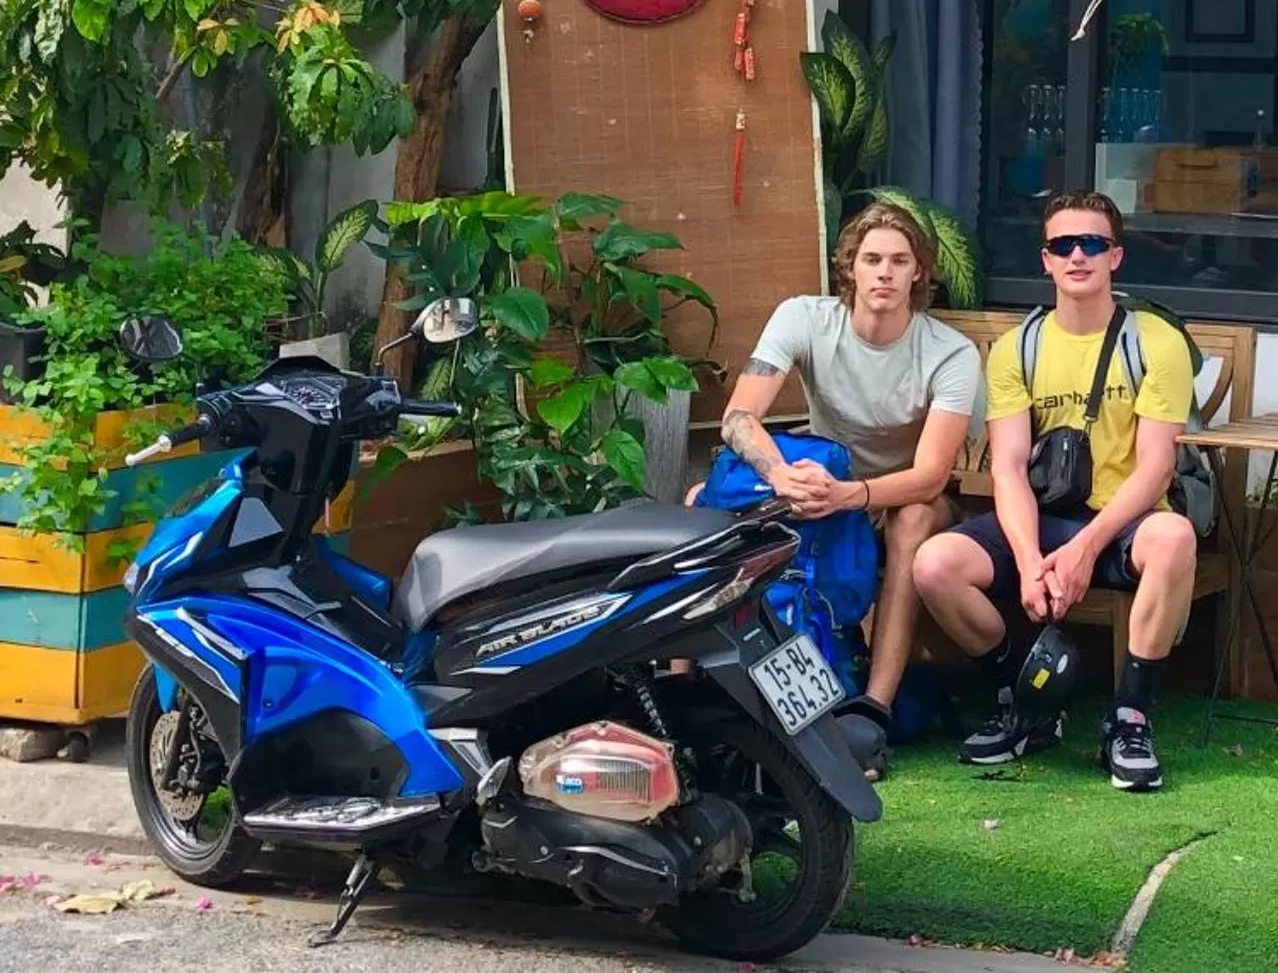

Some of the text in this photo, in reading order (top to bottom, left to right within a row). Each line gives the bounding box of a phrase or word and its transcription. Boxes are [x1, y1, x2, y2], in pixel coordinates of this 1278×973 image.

[1034, 384, 1126, 410] carhatt
[763, 641, 817, 692] 15-B4
[776, 668, 840, 727] 364.32
